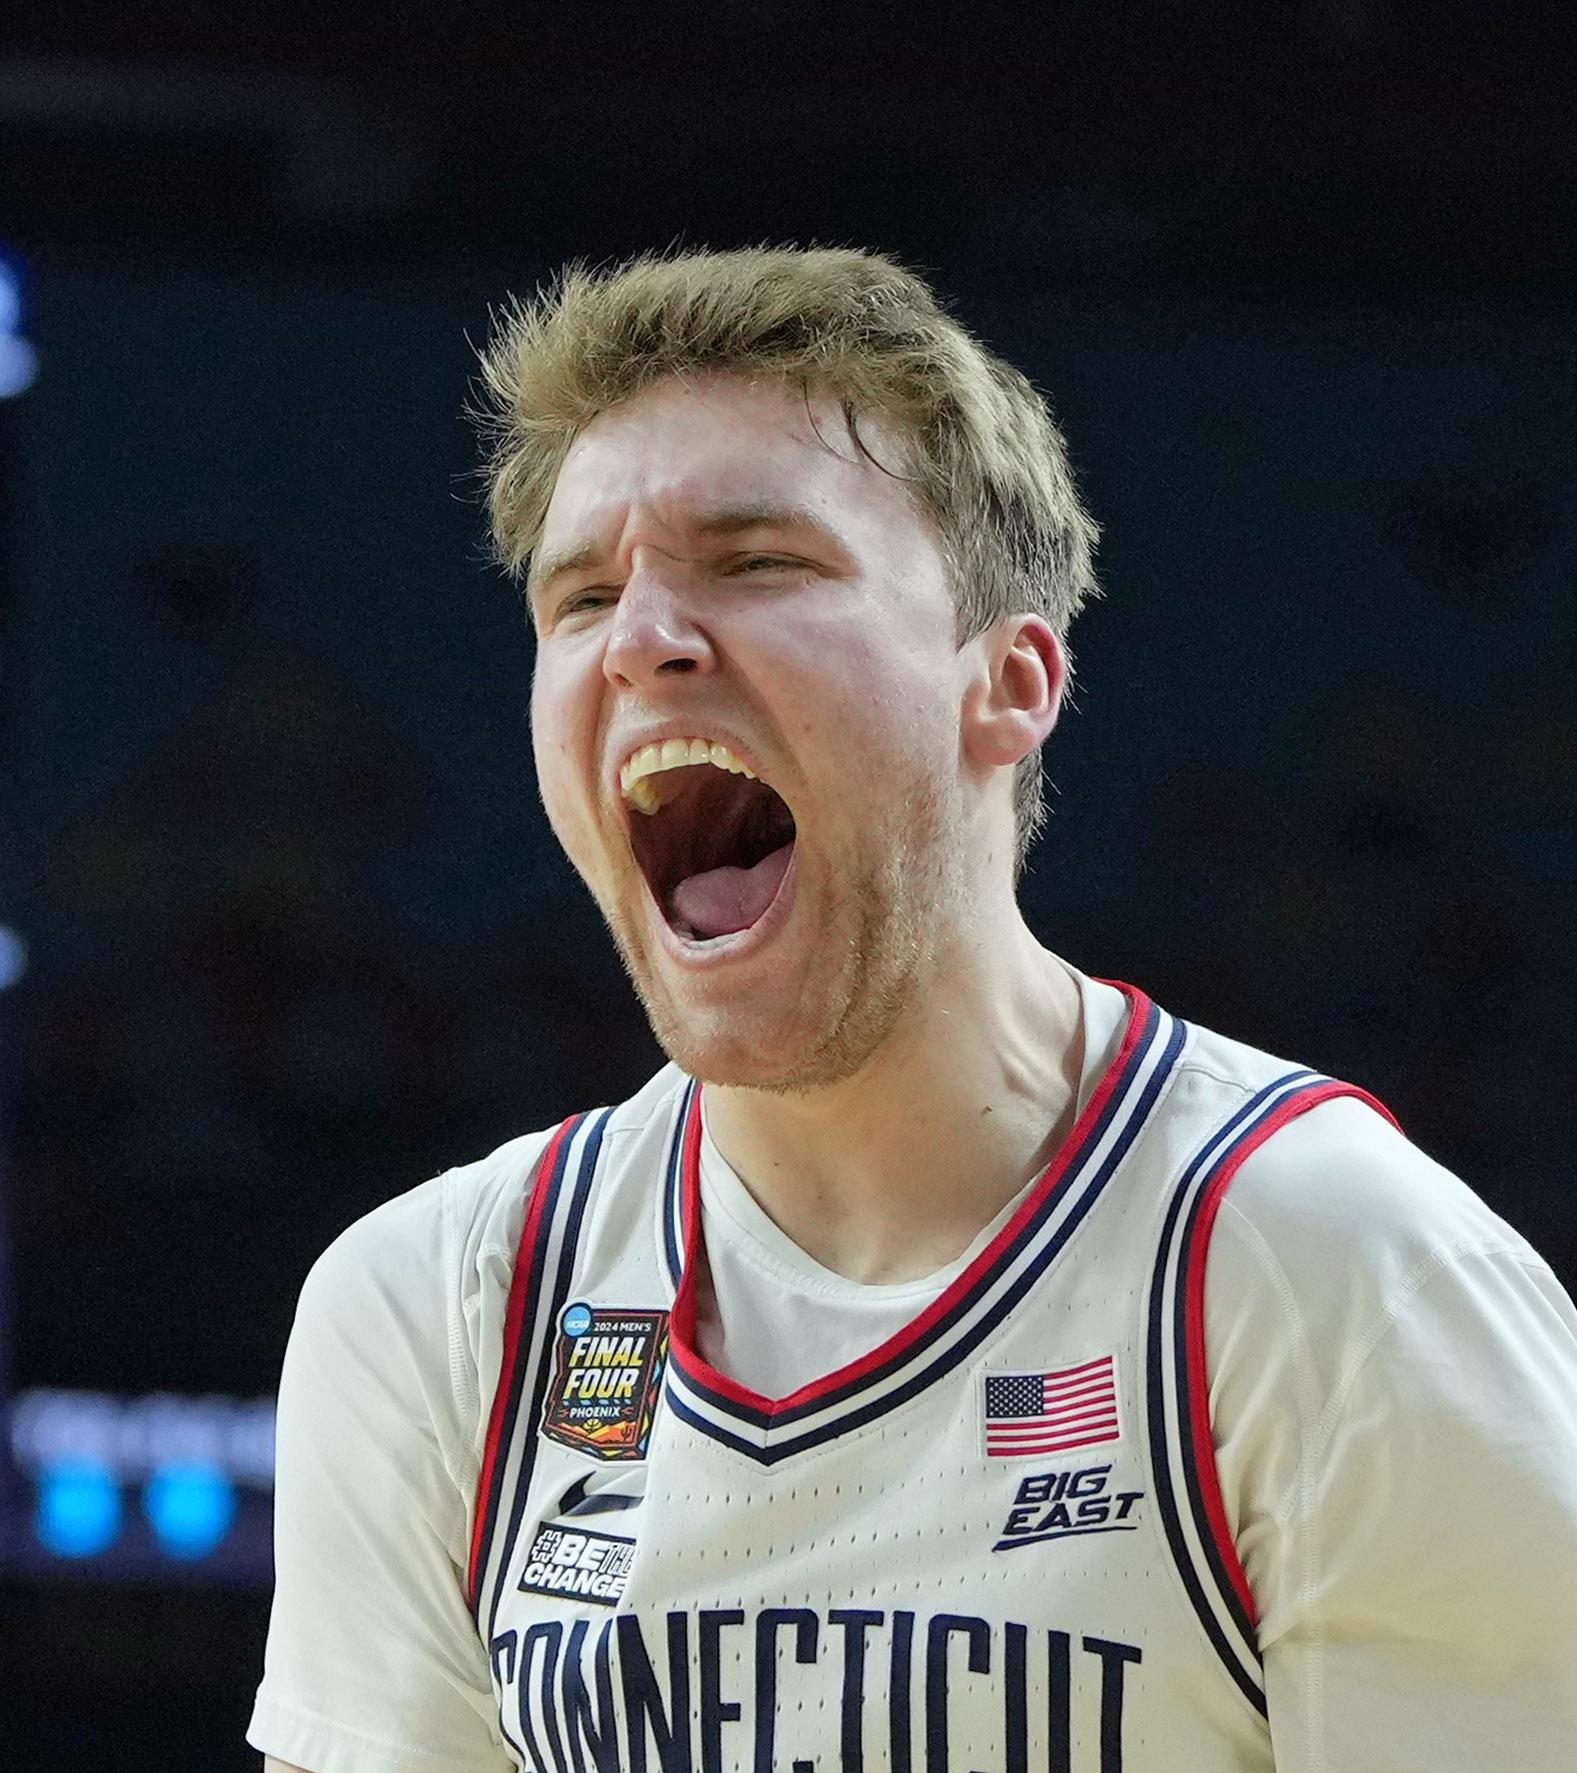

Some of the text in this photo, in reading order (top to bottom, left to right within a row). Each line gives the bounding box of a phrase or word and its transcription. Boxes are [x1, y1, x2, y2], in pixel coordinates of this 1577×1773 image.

[594, 1322, 652, 1332] 2024 MEN'S
[568, 1336, 646, 1367] FINAL
[562, 1368, 640, 1399] FOUR
[569, 1407, 621, 1418] PHOENIX
[1013, 1463, 1112, 1505] BIG
[1002, 1492, 1144, 1535] EAST
[523, 1562, 628, 1599] CHANGE
